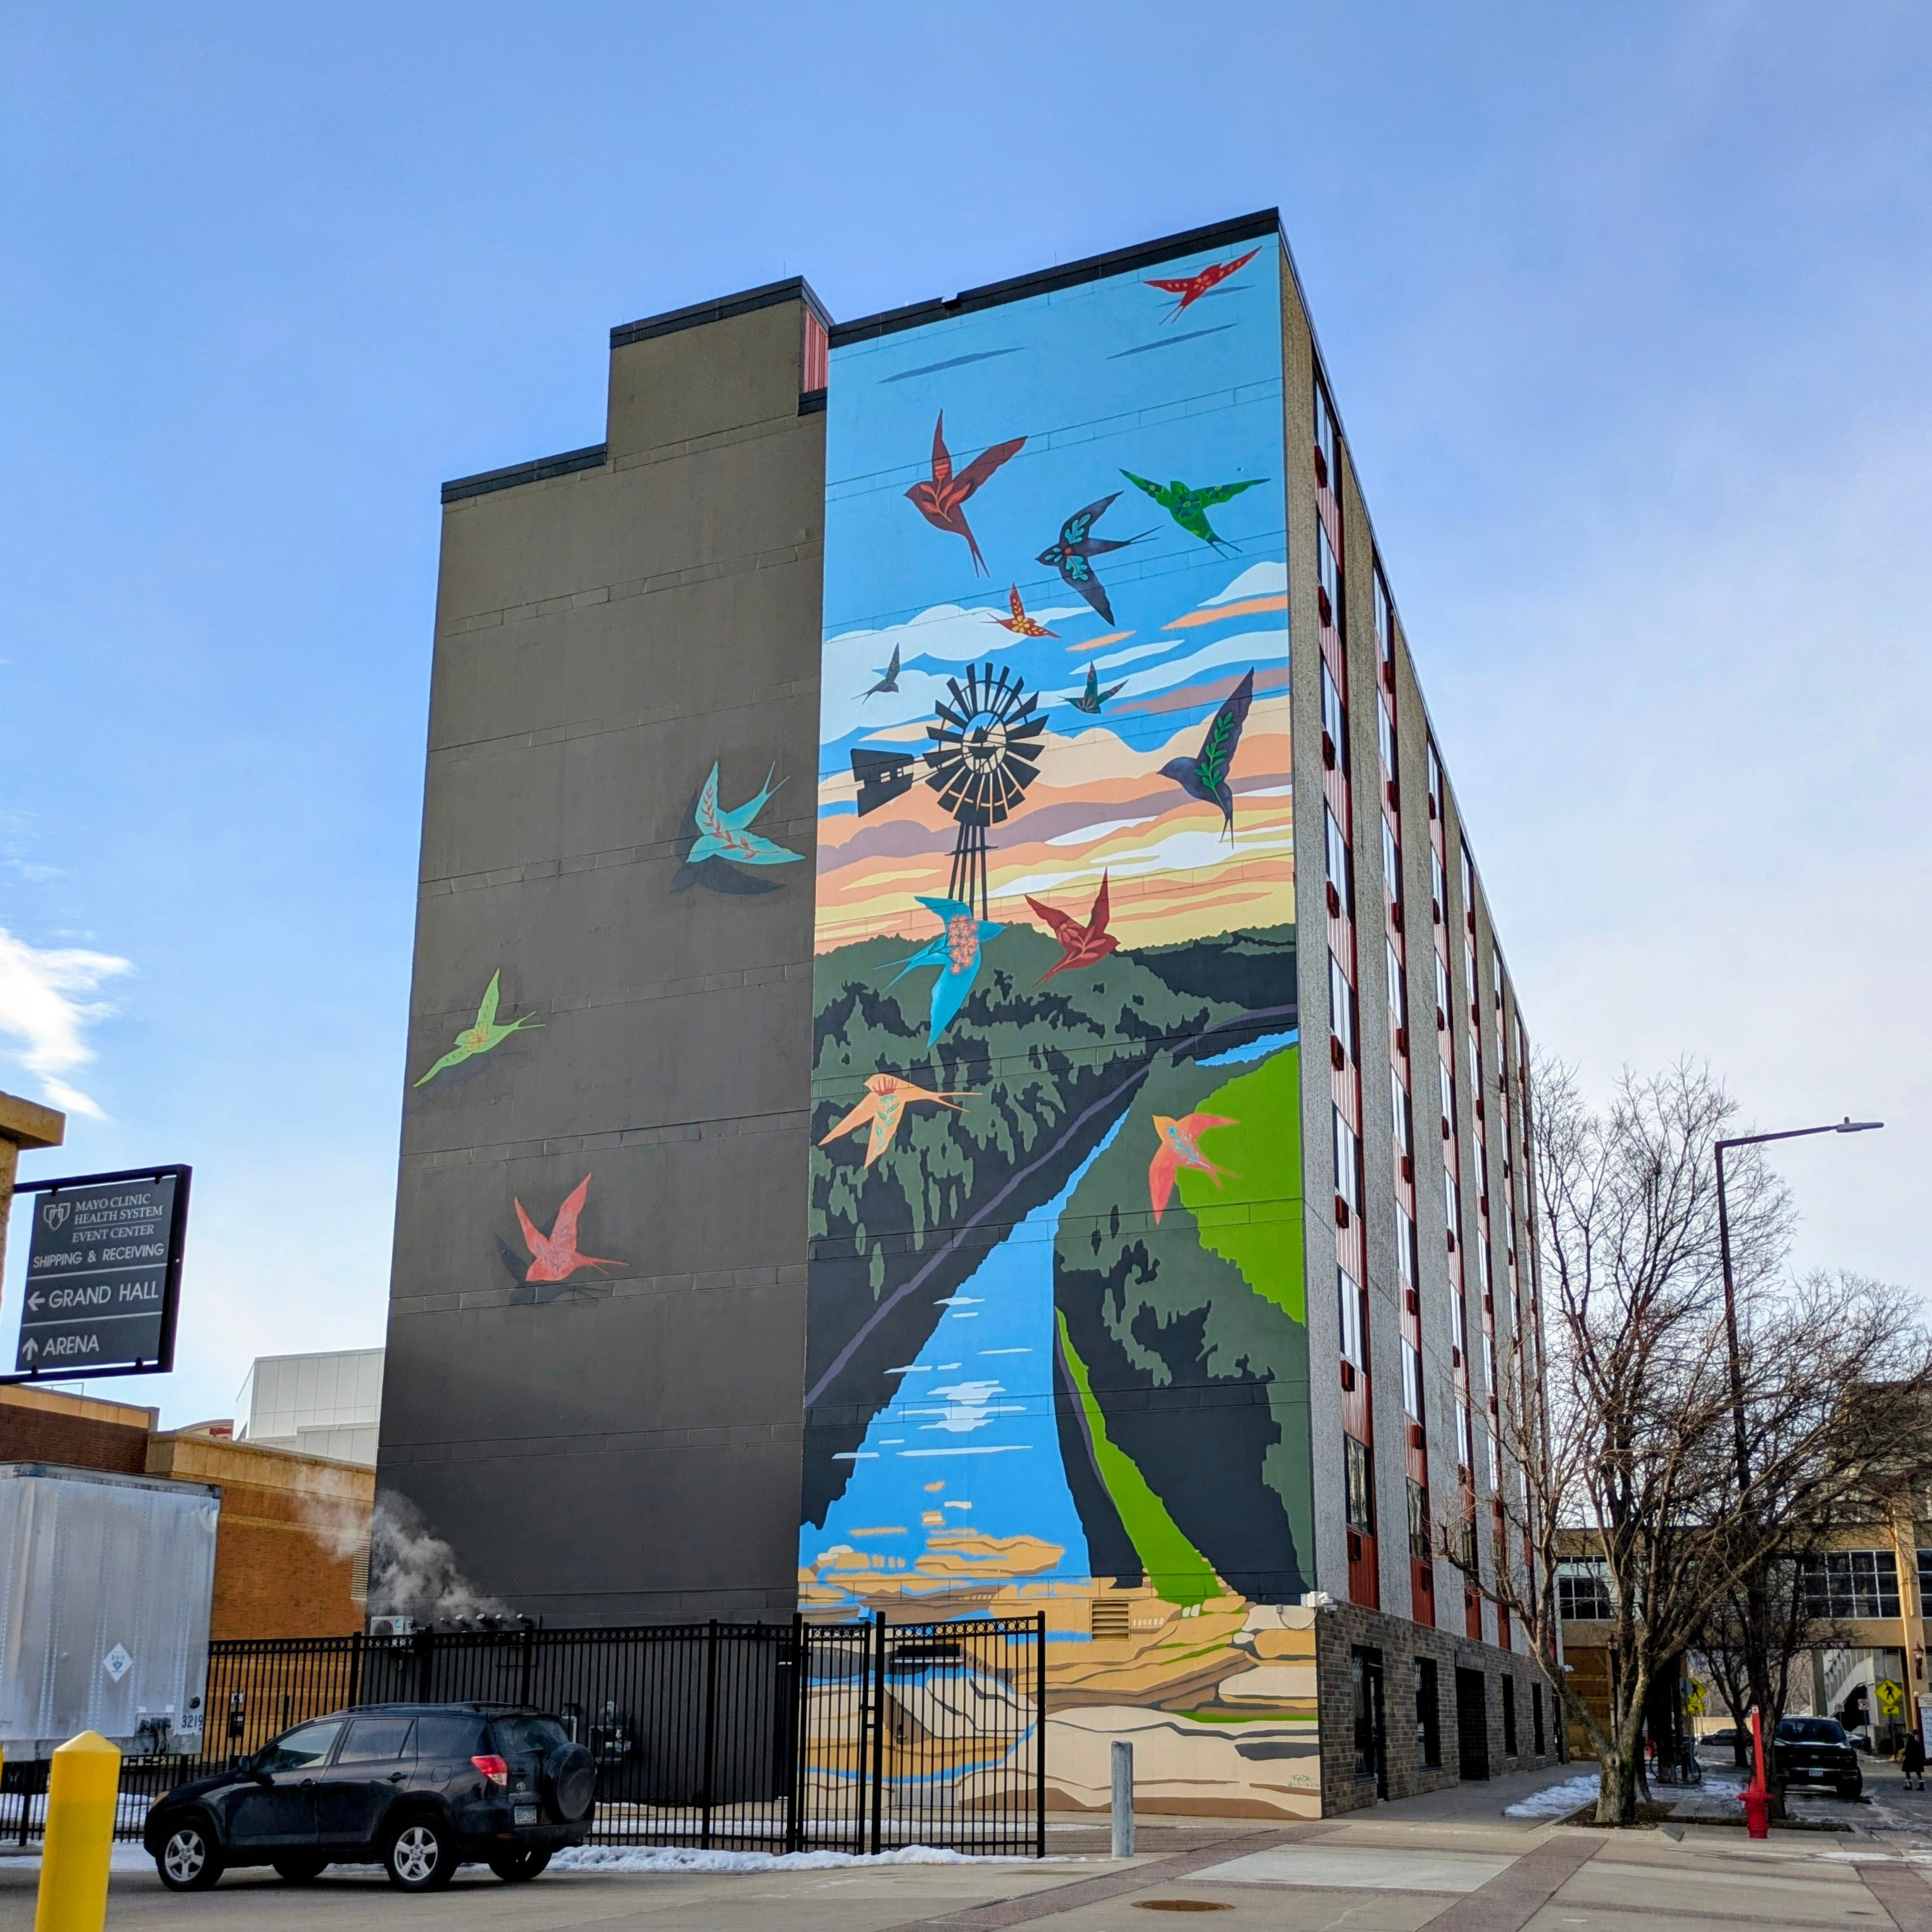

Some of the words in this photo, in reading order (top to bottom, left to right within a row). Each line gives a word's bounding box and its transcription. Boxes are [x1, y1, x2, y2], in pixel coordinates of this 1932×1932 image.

[75, 1198, 108, 1212] MAYO
[110, 1193, 151, 1208] CLINIC
[74, 1210, 118, 1224] HEALTH
[120, 1205, 163, 1219] SYSTEM
[72, 1229, 109, 1242] EVENT
[110, 1224, 154, 1238] CENTER
[33, 1251, 83, 1268] SHIPPING
[87, 1250, 97, 1263] &
[102, 1242, 165, 1261] RECEIVING
[49, 1285, 112, 1309] GRAND
[118, 1280, 159, 1302] HALL
[42, 1334, 100, 1356] ARENA
[181, 1715, 203, 1728] 3219
